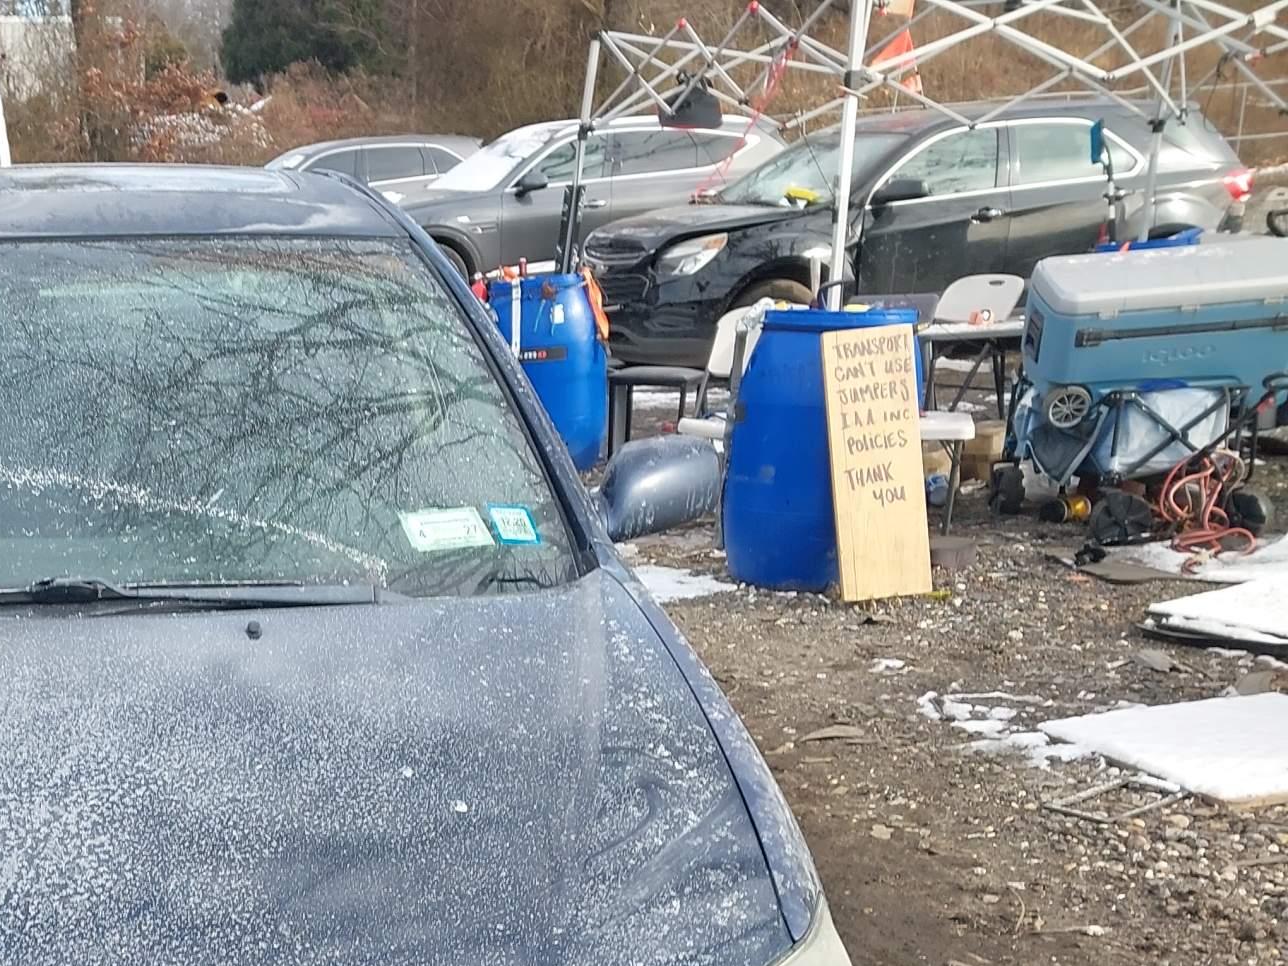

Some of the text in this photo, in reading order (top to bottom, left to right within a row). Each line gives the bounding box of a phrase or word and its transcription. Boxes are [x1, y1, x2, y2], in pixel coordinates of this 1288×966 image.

[832, 333, 911, 359] TRANSPORT
[834, 357, 912, 382] CAN'T USE
[837, 379, 910, 405] JUMPERS
[845, 462, 894, 490] THANK
